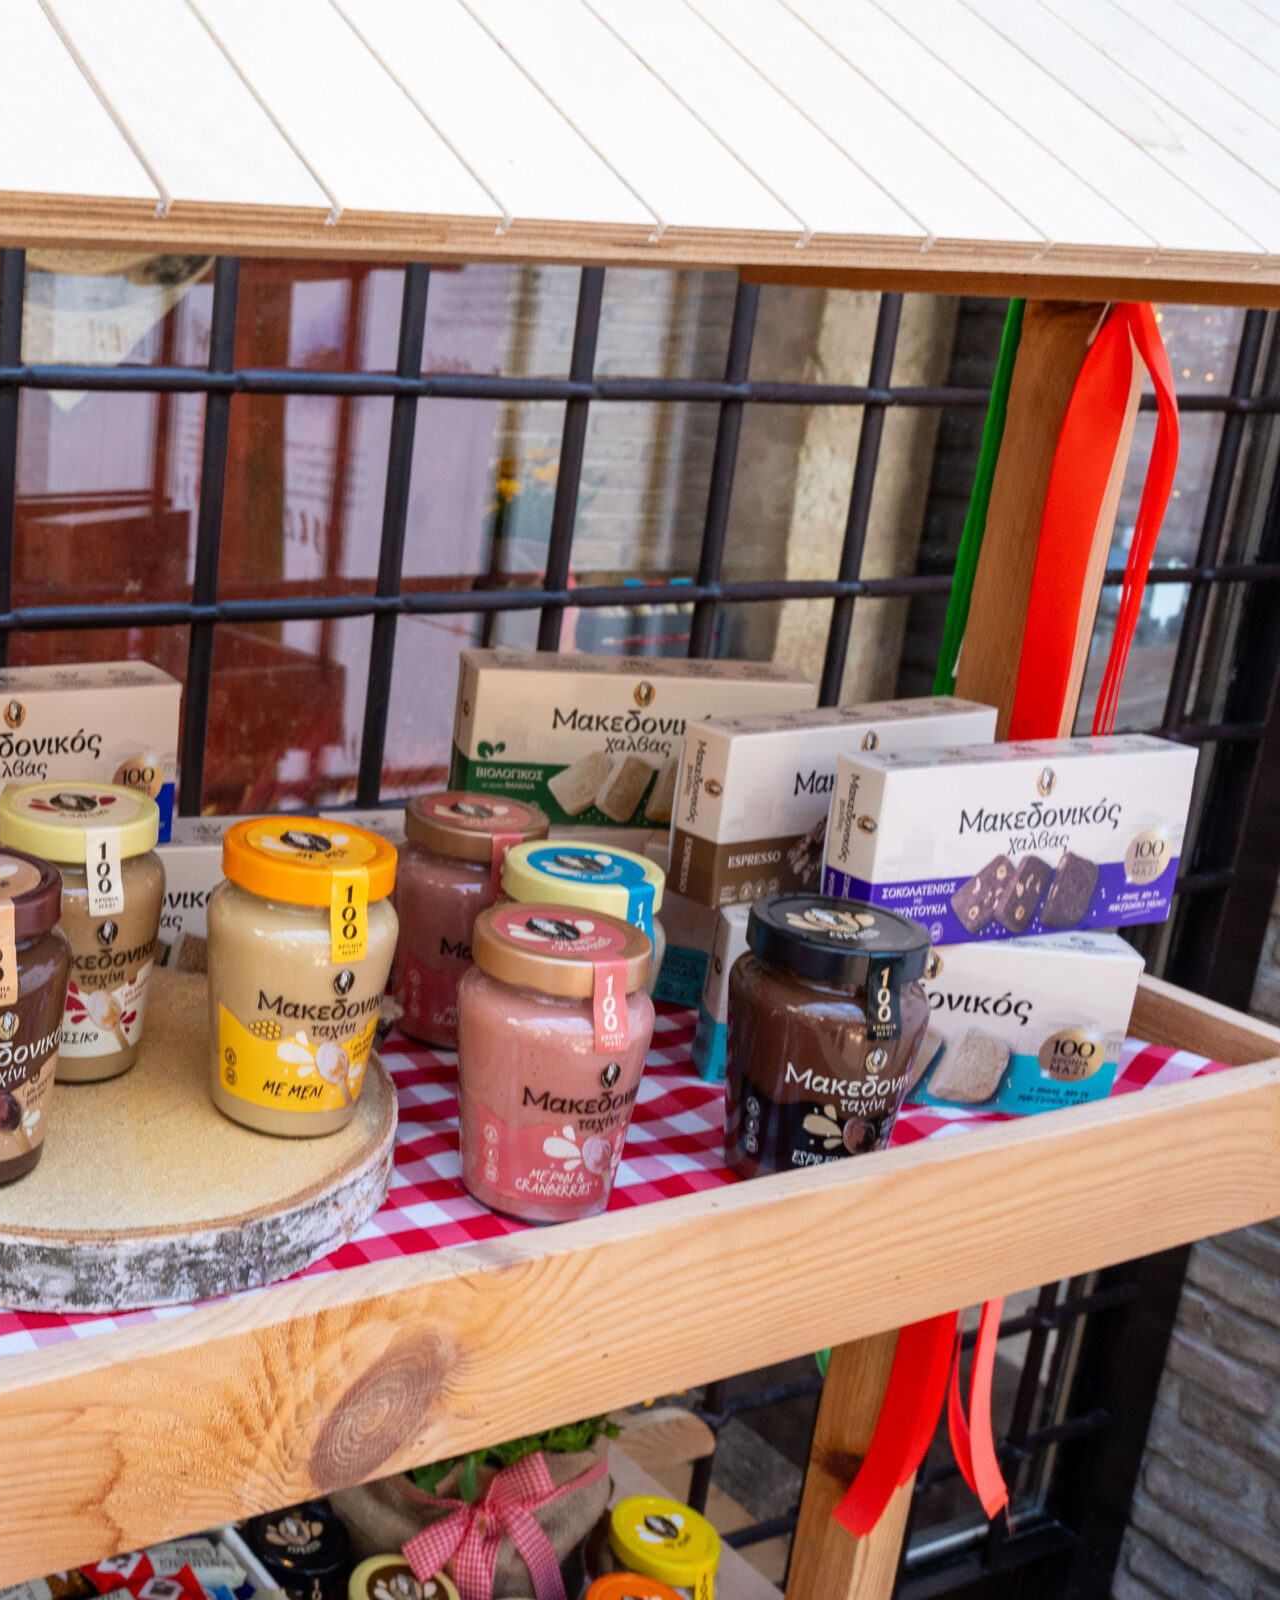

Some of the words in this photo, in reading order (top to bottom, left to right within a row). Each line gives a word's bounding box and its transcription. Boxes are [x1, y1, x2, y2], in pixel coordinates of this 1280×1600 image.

[552, 708, 686, 735] Μακεδονι
[605, 735, 671, 757] χαλβάς
[121, 767, 155, 785] 100
[476, 766, 544, 781] ΒΙΟΛΟΓΙΚΟΣ
[958, 798, 1122, 833] Μακεδονικός
[1007, 831, 1070, 854] χαλβάς
[1135, 840, 1165, 858] 100
[97, 840, 112, 894] 100
[727, 850, 782, 869] ESPRESSO
[881, 882, 956, 900] ΣΟΚΟΛΑΤΕΝΙΟΣ
[342, 884, 357, 939] 100
[893, 904, 947, 918] ΟΥΝΤΟΥΚΙΑ
[80, 969, 125, 989] ταχίνι
[603, 975, 618, 1031] 100
[878, 967, 891, 1023] 100
[312, 1020, 357, 1040] ταχίνι
[1054, 1040, 1095, 1058] 100
[1049, 1064, 1085, 1075] ΜΑΖΙ
[262, 1080, 284, 1096] ΜΕ
[288, 1084, 323, 1100] ΜΕΛΙ
[841, 1096, 886, 1117] ταχίνι
[578, 1111, 620, 1133] ταχίνι
[529, 1168, 550, 1182] ΜΕ
[577, 1171, 584, 1183] &
[515, 1177, 592, 1198] CRANBERRIES
